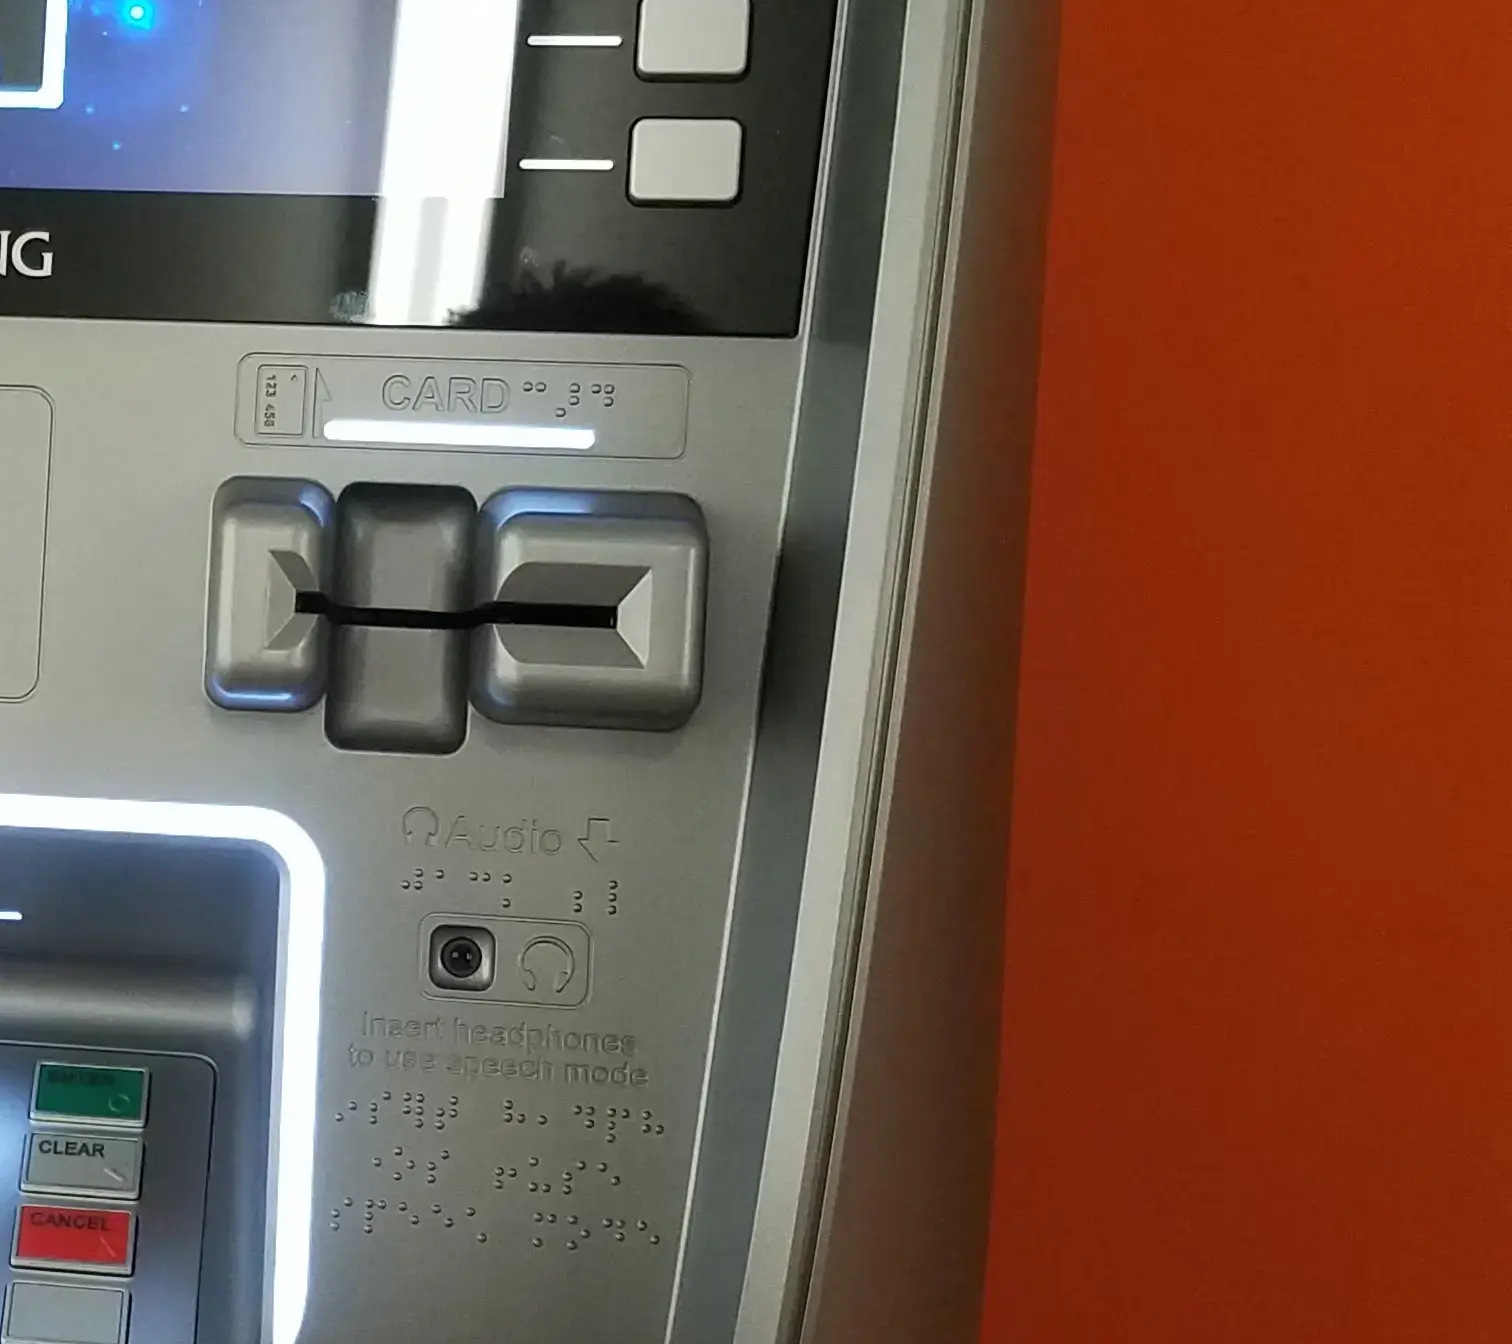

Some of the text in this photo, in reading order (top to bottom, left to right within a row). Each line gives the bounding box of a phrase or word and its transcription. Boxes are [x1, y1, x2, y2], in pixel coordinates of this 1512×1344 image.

[380, 373, 512, 414] CARD
[445, 813, 564, 856] Audio
[362, 1011, 639, 1058] Insert headphones
[348, 1042, 650, 1088] to use speech mode
[38, 1139, 106, 1158] CLEAR
[30, 1212, 112, 1231] CANCEL
